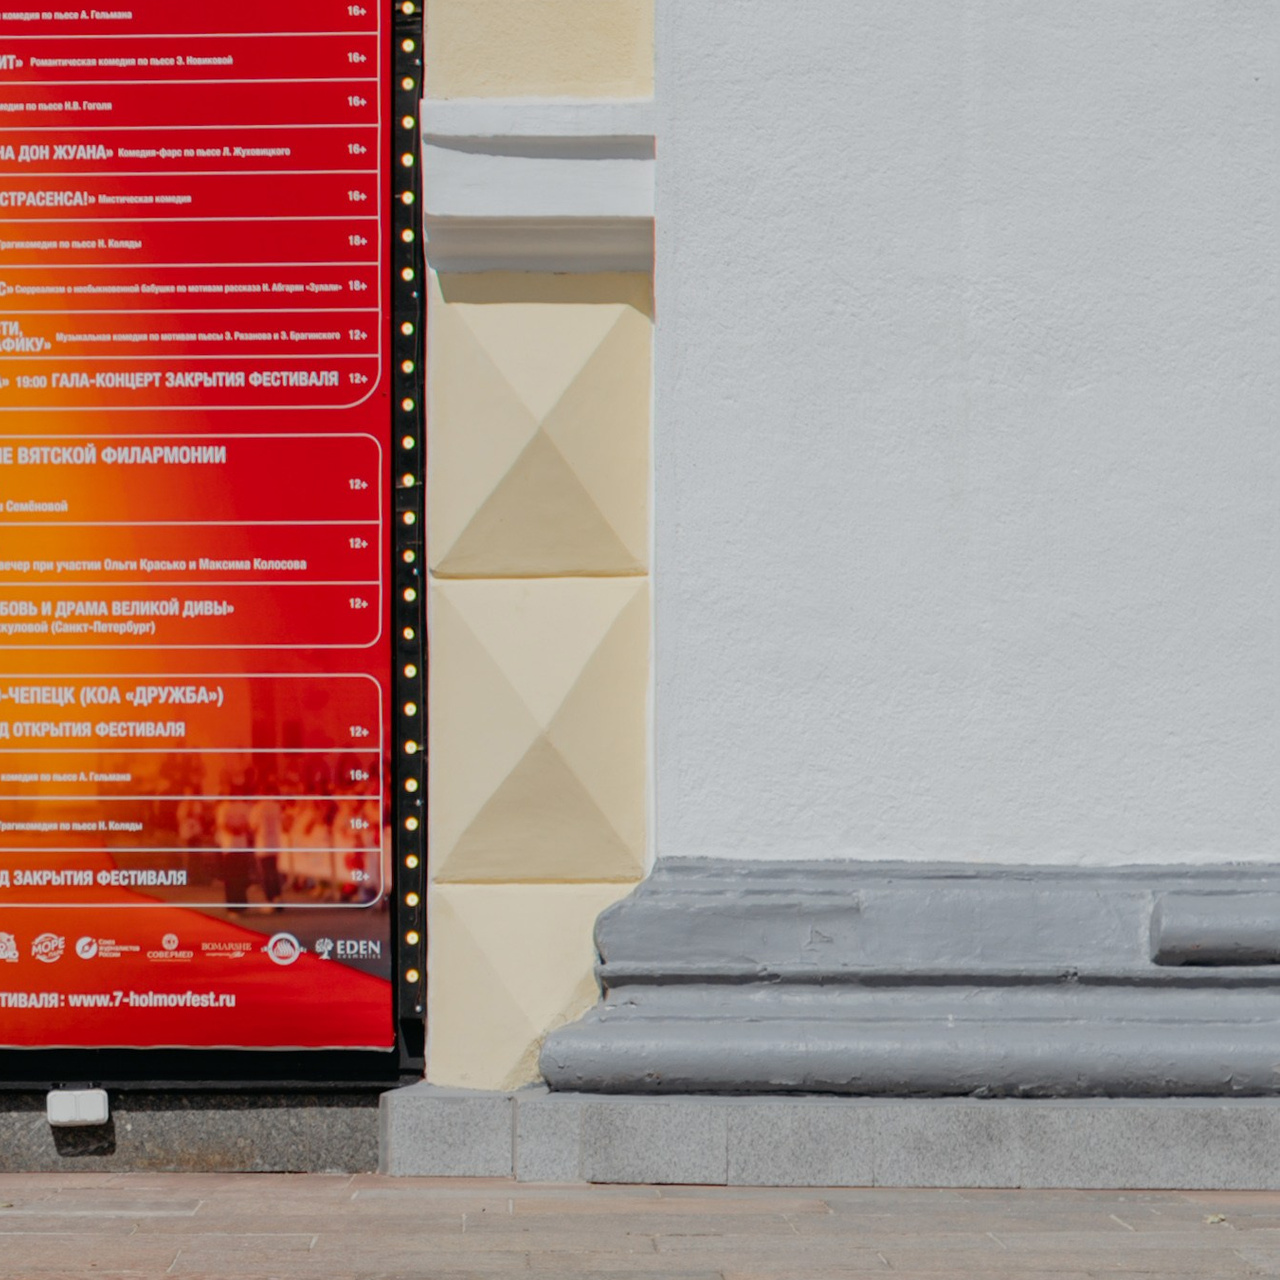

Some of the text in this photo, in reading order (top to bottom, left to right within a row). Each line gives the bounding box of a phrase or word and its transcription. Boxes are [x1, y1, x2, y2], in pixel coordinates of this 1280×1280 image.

[42, 12, 52, 20] по
[80, 10, 89, 19] А.
[18, 145, 49, 162] ДОН
[53, 144, 113, 160] ЖУАНА»
[17, 375, 47, 388] 19:00
[51, 372, 162, 390] ГАЛА-КОНЦЕРТ
[165, 371, 245, 387] ЗАКРЫТИЯ
[249, 371, 339, 387] ФЕСТИВАЛЯ
[17, 443, 97, 464] ВЯТСКОЙ
[101, 446, 226, 464] ФИЛАРМОНИИ
[140, 558, 186, 572] Красько
[189, 560, 197, 570] и
[41, 601, 52, 616] И
[55, 601, 108, 618] ДРАМА
[112, 598, 179, 616] ВЕЛИКОЙ
[182, 600, 234, 618] ДИВЫ»
[51, 620, 156, 635] (Санкт-Петербург)
[80, 686, 121, 707] (КОА
[126, 686, 224, 707] «ДРУЖБА»)
[13, 721, 92, 737] ОТКРЫТИЯ
[95, 721, 186, 737] ФЕСТИВАЛЯ
[13, 870, 93, 886] ЗАКРЫТИЯ
[97, 870, 187, 886] ФЕСТИВАЛЯ
[336, 939, 381, 955] EDEN
[68, 991, 236, 1007] www.7-holmovfest.ru
